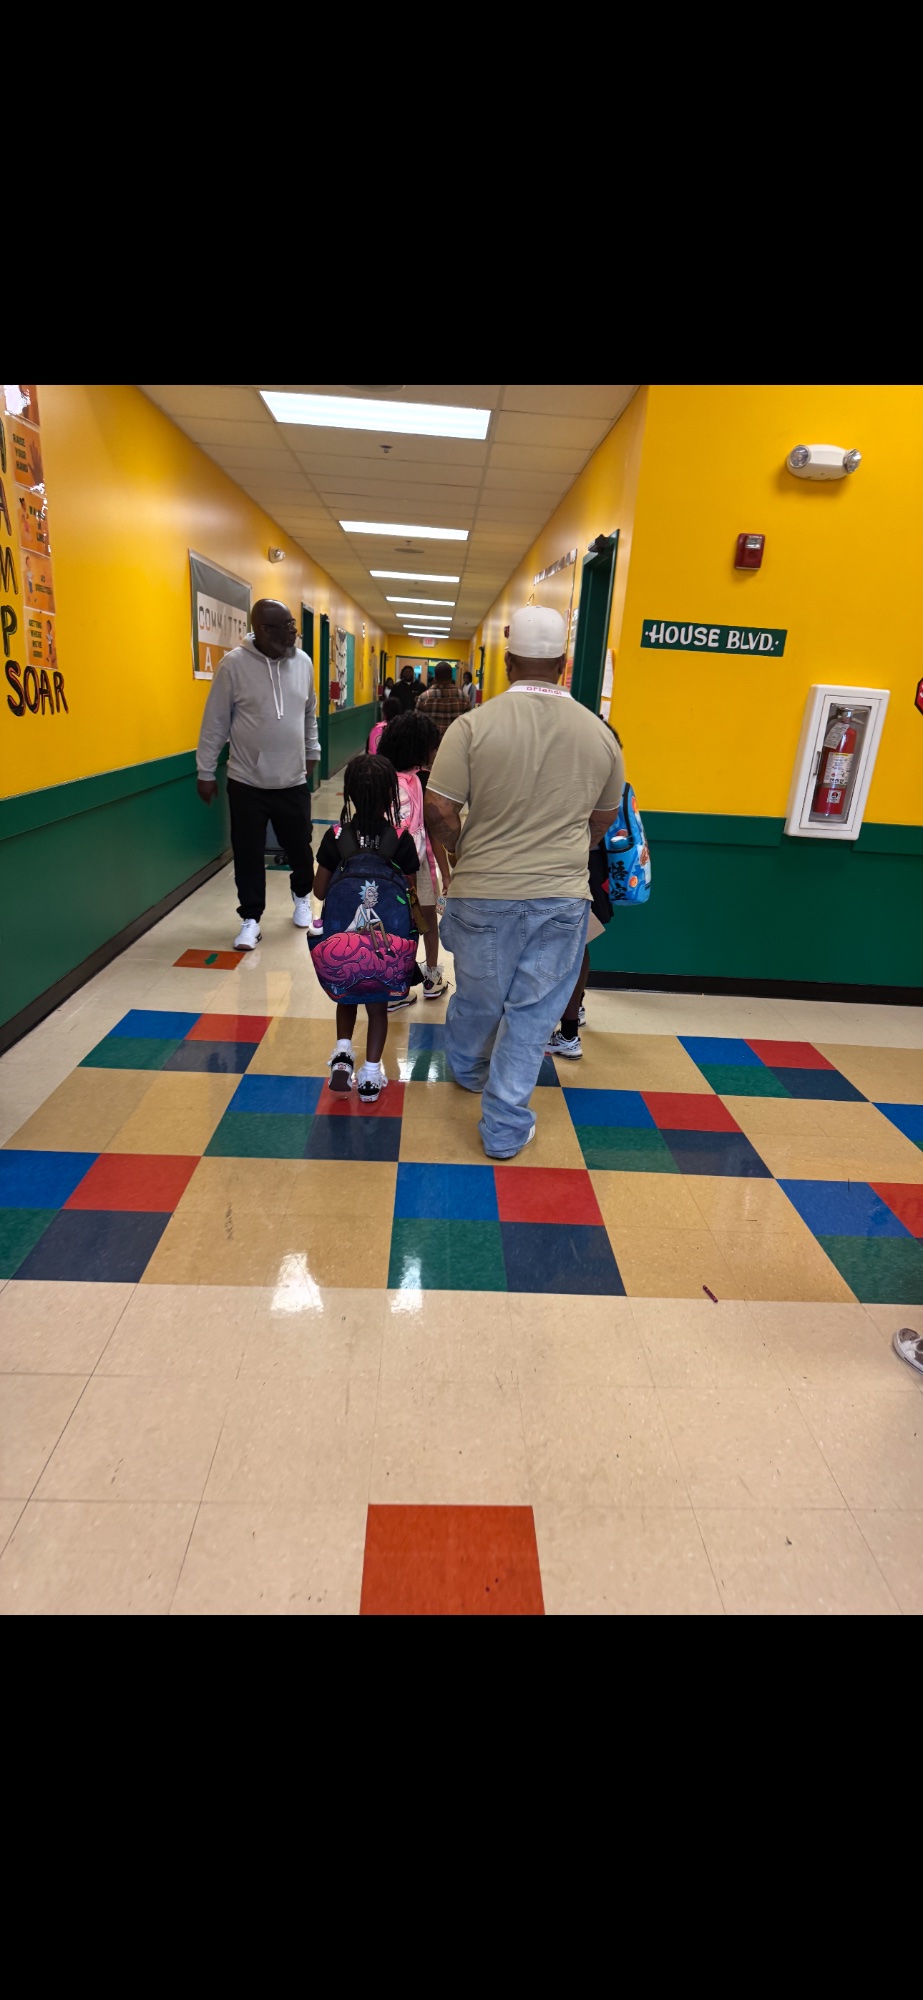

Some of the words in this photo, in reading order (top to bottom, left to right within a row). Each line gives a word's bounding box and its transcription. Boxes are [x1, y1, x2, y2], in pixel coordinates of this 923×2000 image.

[649, 622, 721, 648] HOUSE
[725, 630, 775, 651] BLVD.
[5, 659, 69, 717] SOAR
